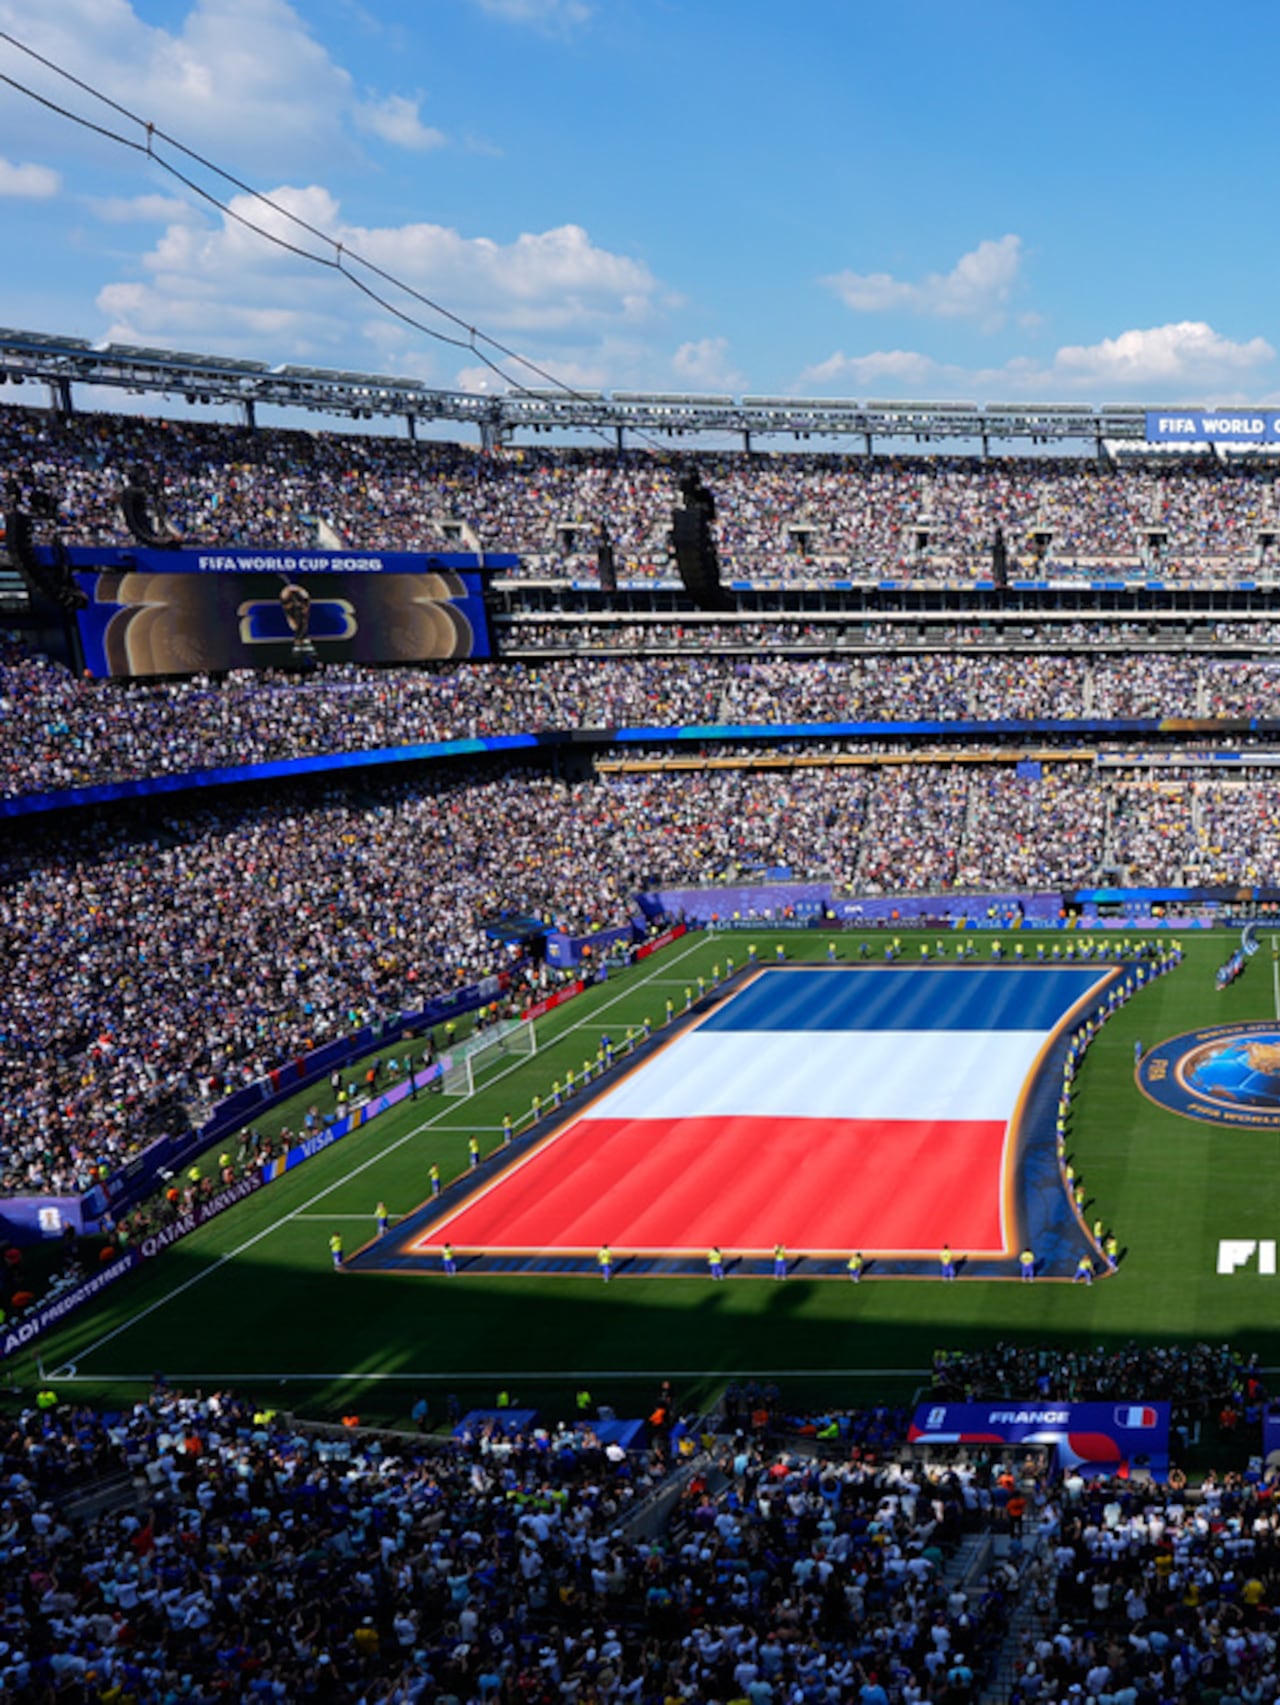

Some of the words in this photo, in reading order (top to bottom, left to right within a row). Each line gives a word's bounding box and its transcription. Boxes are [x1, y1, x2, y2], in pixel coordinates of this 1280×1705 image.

[1158, 418, 1197, 434] FIFA
[1202, 418, 1265, 434] WORLD
[198, 556, 237, 570] FIFA
[236, 557, 296, 571] WORLD
[298, 558, 329, 571] CUP
[331, 558, 383, 572] 2026
[301, 1129, 334, 1158] VISA
[141, 1213, 198, 1257] QATAR
[199, 1174, 262, 1221] AIRWAYS
[4, 1319, 41, 1353] ADI
[40, 1255, 134, 1327] PREDICTSTREET
[988, 1411, 1070, 1425] FRANCE
